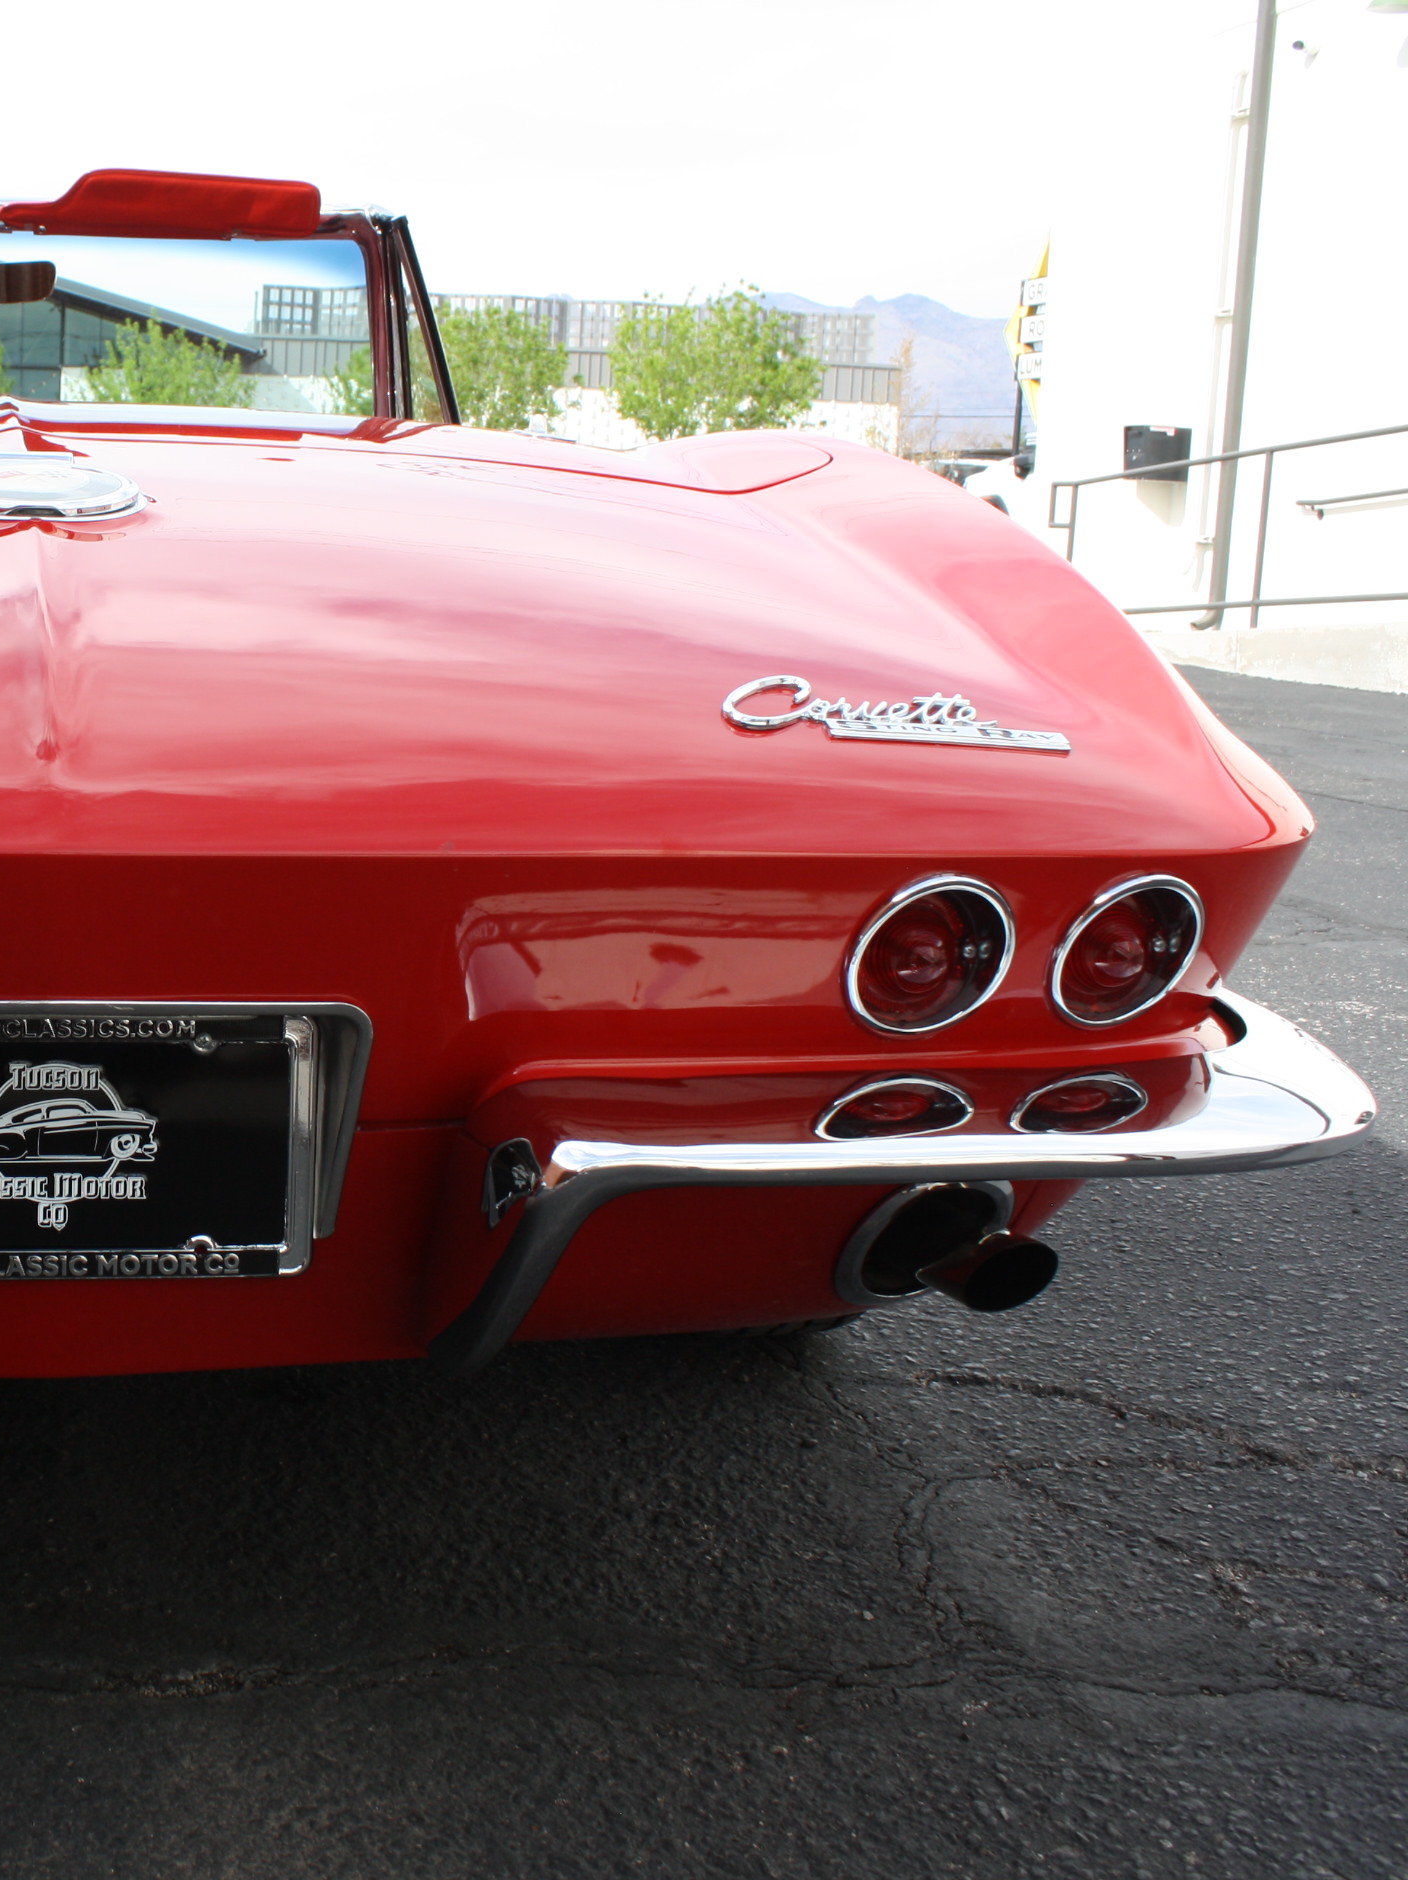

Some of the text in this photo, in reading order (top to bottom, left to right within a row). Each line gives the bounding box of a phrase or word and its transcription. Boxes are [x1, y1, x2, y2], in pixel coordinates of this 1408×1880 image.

[1028, 283, 1048, 300] GR
[722, 674, 998, 730] Corvette
[9, 1064, 100, 1091] TUCSON
[53, 1173, 146, 1200] MOTOR
[95, 1254, 198, 1276] MOTOR
